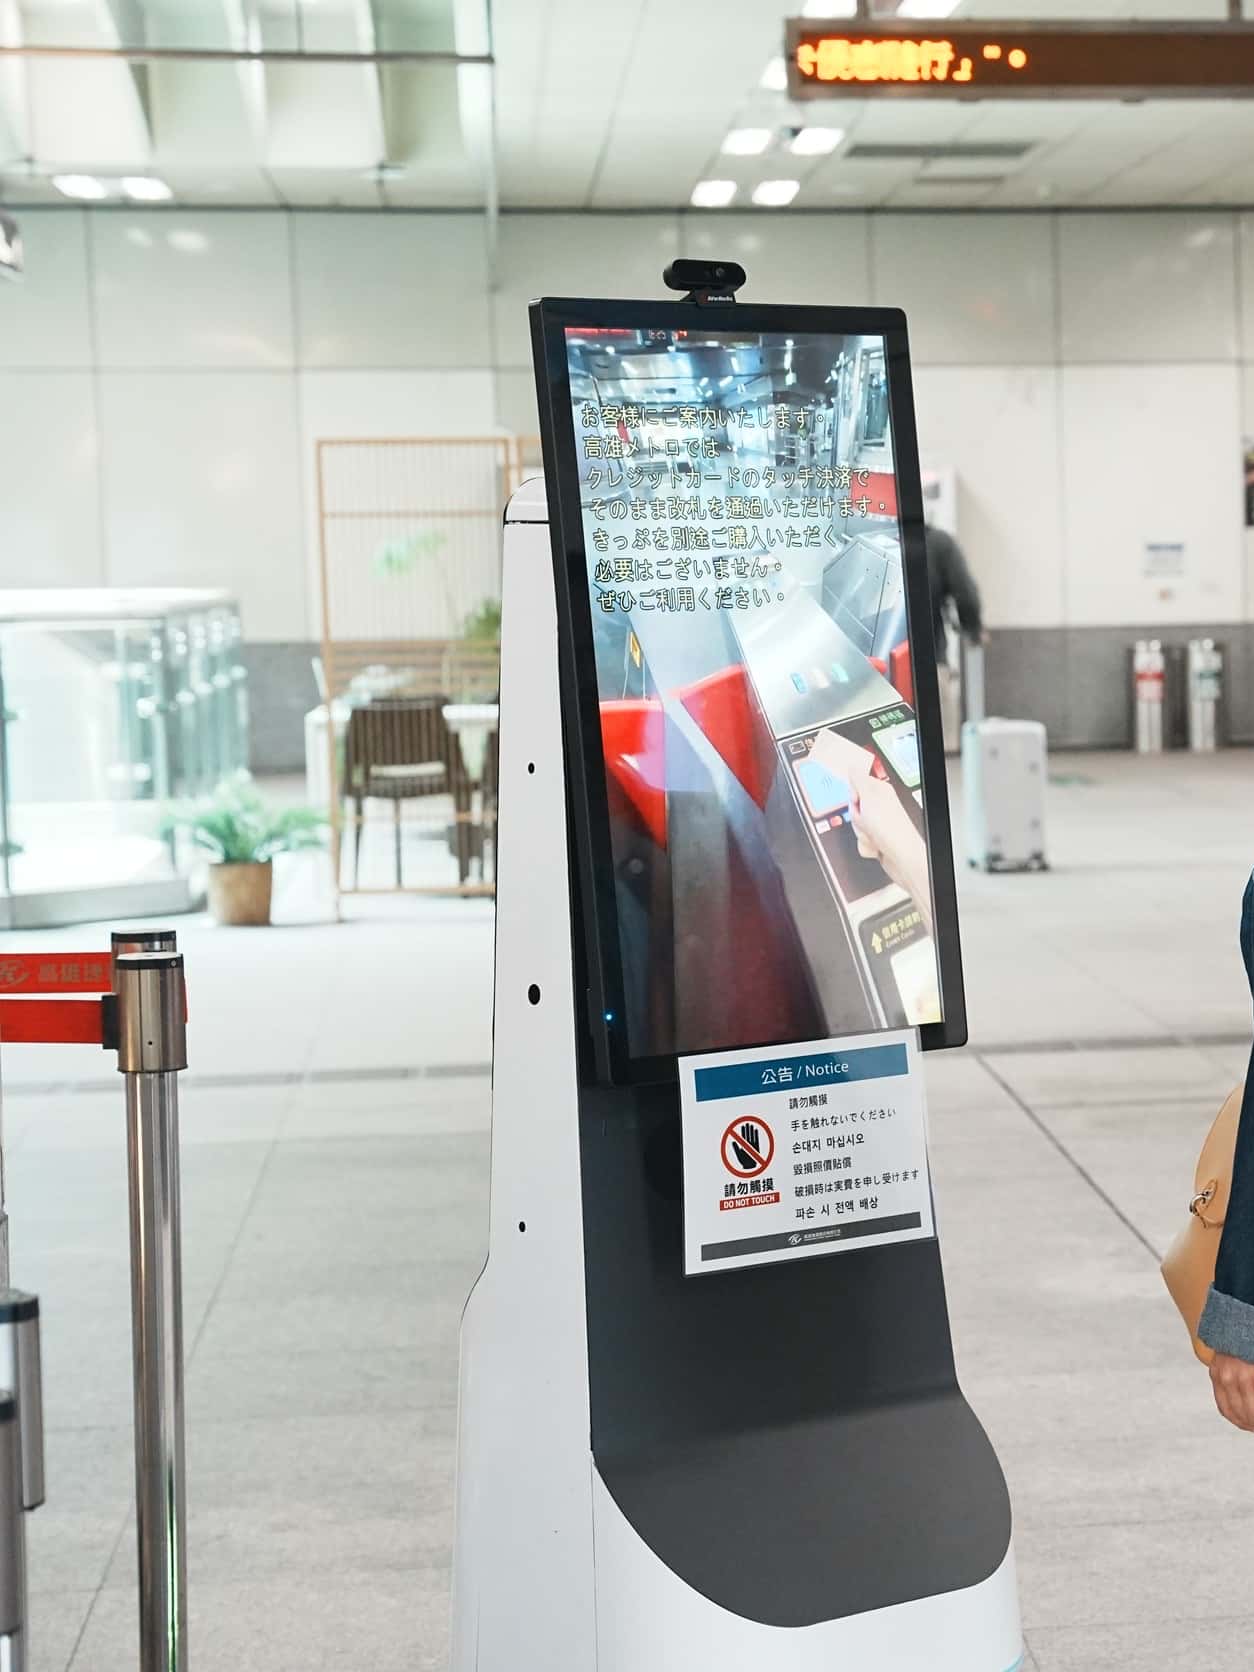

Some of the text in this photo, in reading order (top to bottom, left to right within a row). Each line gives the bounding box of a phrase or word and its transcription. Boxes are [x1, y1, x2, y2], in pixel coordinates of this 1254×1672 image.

[581, 404, 825, 429] お客様にご案内いたします。
[583, 434, 733, 460] 高雄メトロでは、
[587, 464, 870, 490] クレジットカードのタッチ決済で
[590, 495, 887, 521] そのまま改札を通過いただけます。
[592, 525, 837, 551] きっぷを別途ご購入いただく
[594, 556, 782, 583] 必要はございません。
[597, 585, 785, 613] ぜひご利用ください。
[761, 1062, 849, 1085] 公告 / Notice
[789, 1093, 828, 1110] 請勿觸摸
[791, 1108, 897, 1132] 手を触れないでください
[792, 1133, 865, 1154] 손대지 마십시오
[724, 1177, 774, 1198] 請勿觸摸
[794, 1169, 919, 1198] 破損時は実費を申し受けます
[723, 1194, 775, 1209] DO NOT TOUCH
[795, 1196, 878, 1220] 파손 시 전액 배상
